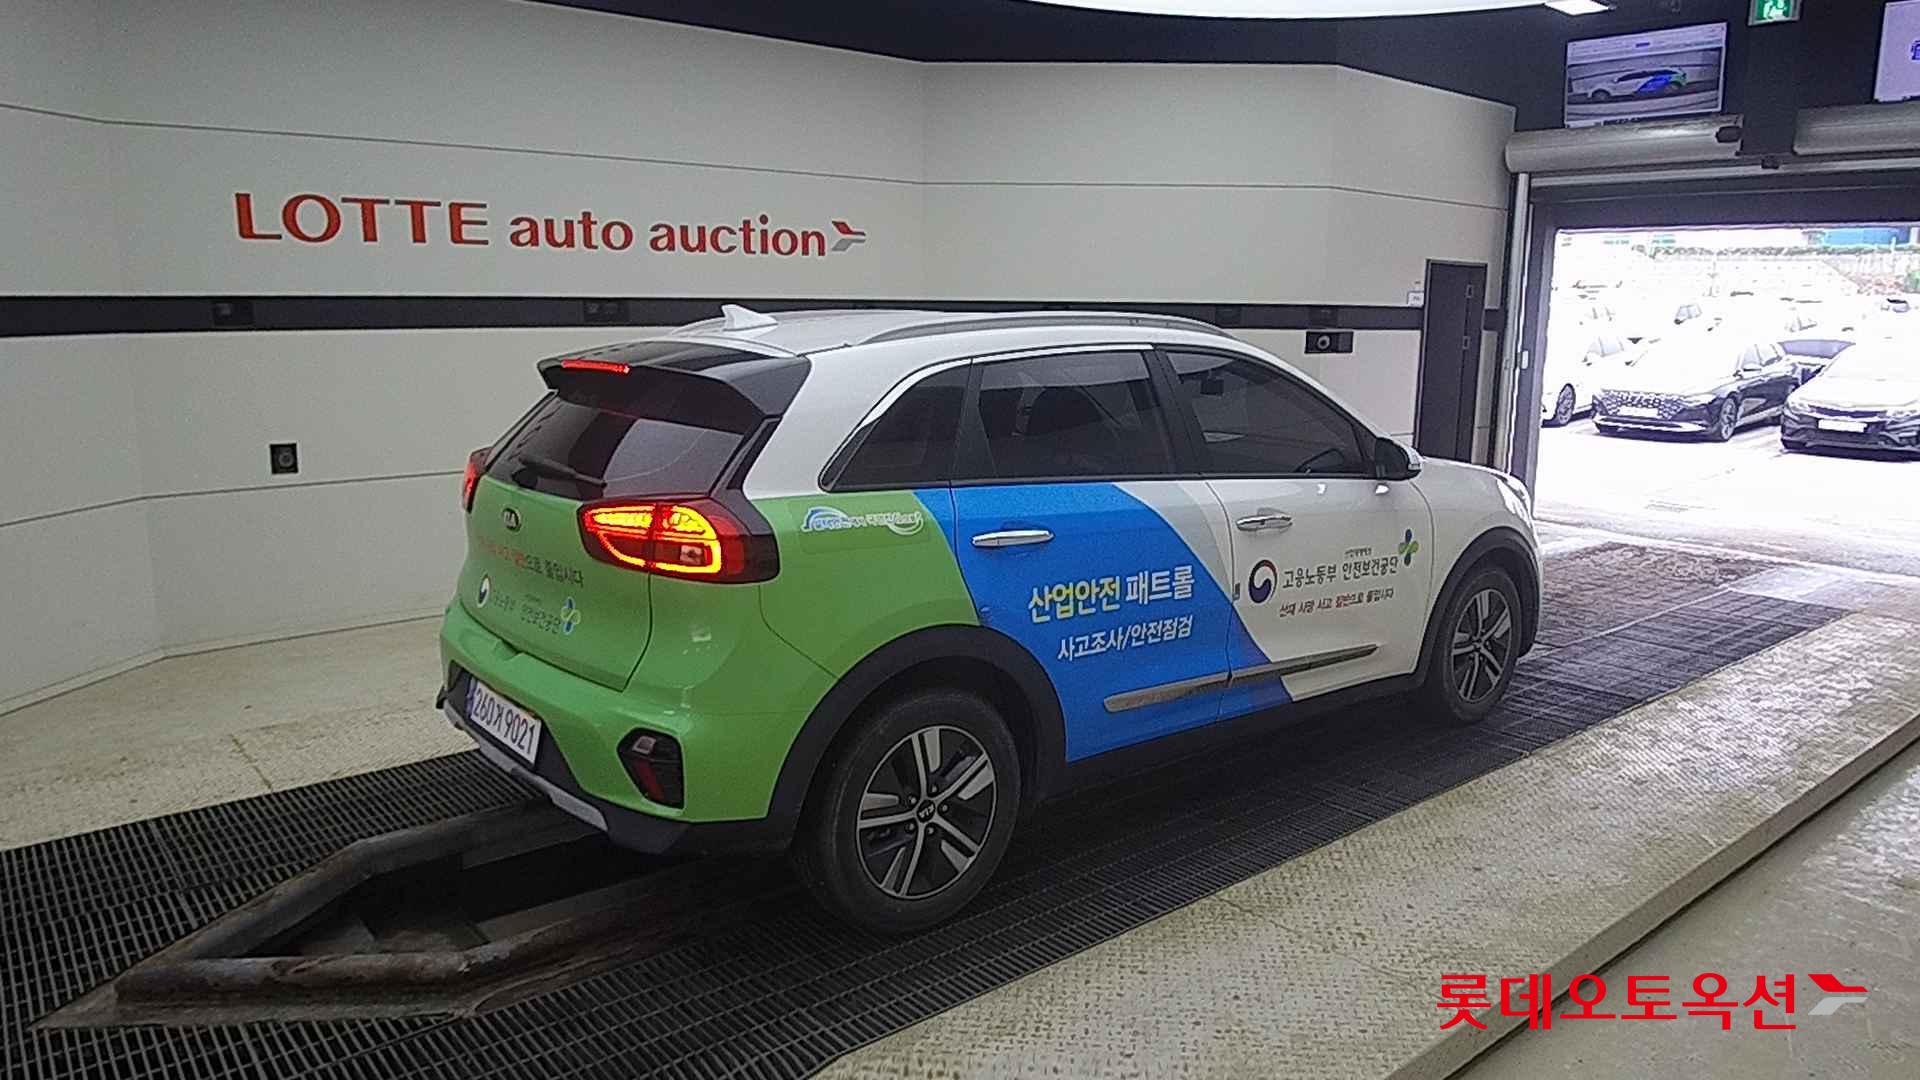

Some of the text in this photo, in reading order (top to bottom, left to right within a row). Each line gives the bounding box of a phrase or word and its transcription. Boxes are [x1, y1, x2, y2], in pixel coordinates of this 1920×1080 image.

[235, 192, 826, 257] LOTTE auto auction
[1028, 565, 1195, 623] 산업안전 패트롤
[1282, 556, 1400, 589] 고용노동부 안전보건공단
[1057, 615, 1193, 661] 사고조사/안전점검
